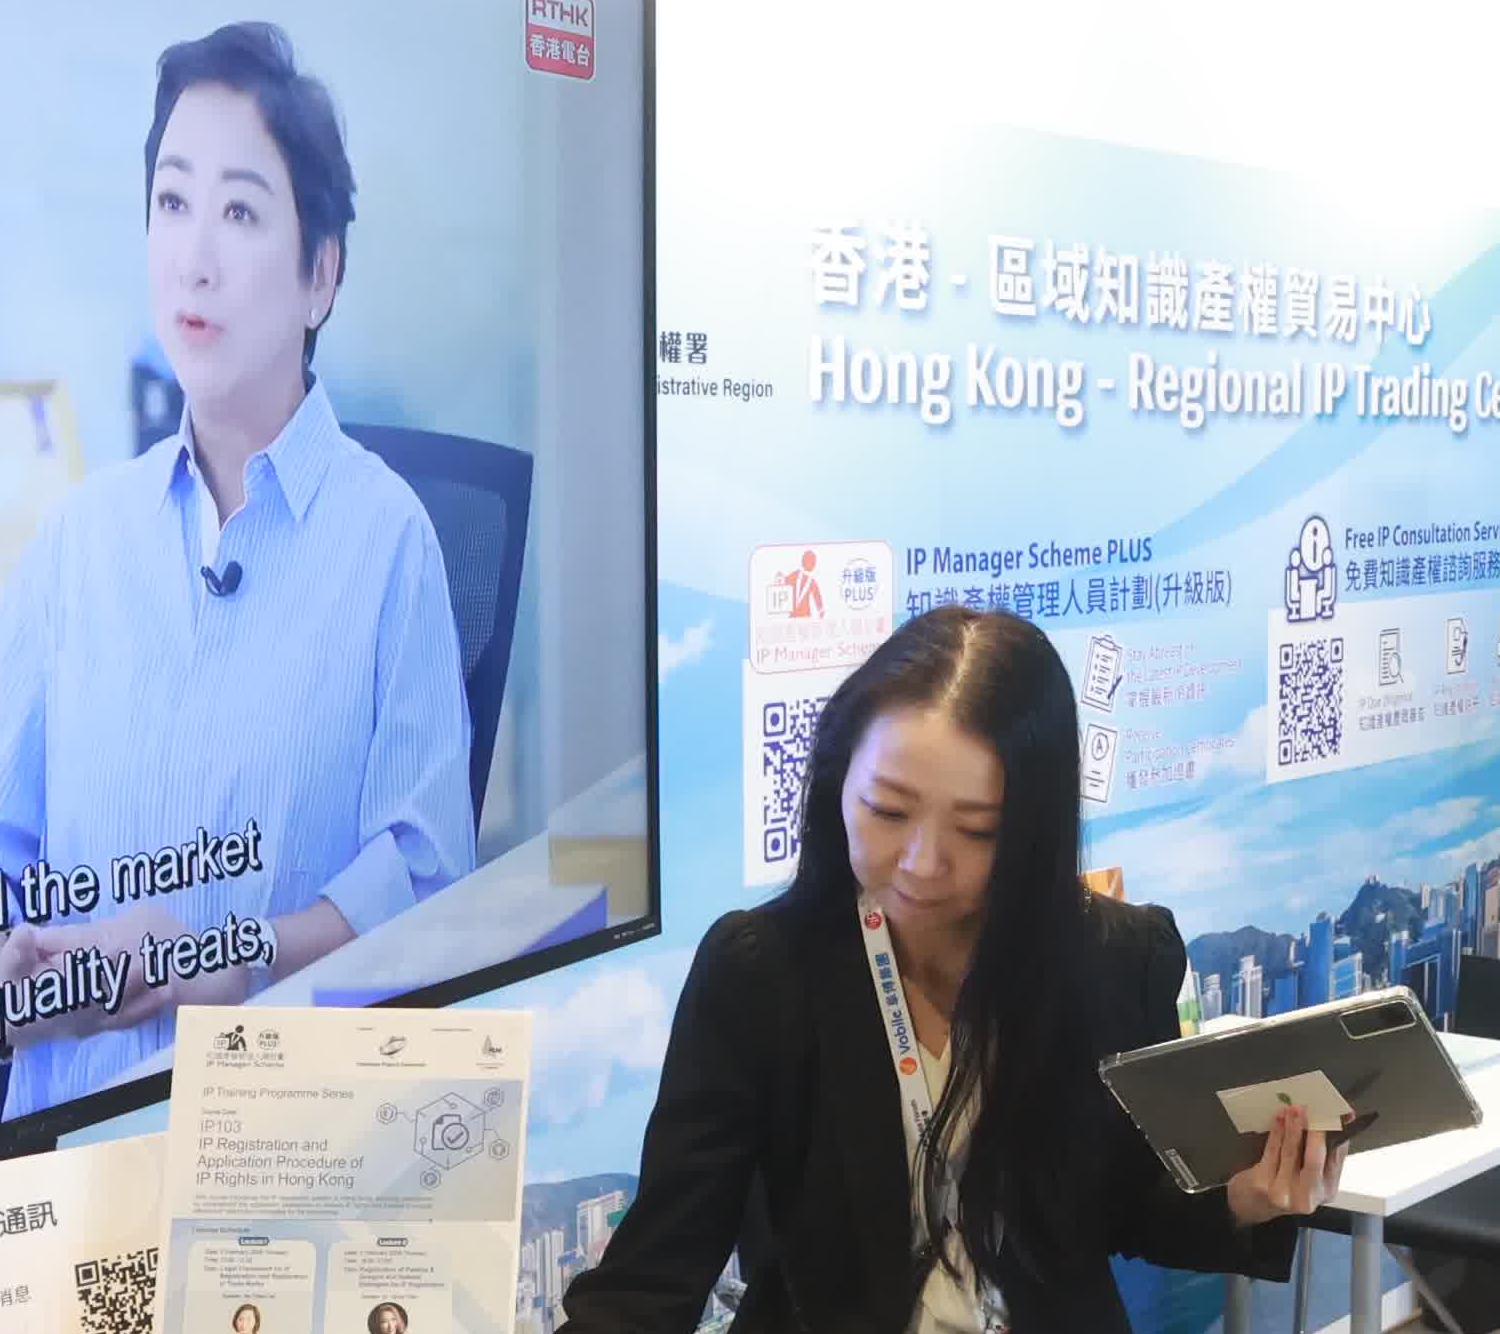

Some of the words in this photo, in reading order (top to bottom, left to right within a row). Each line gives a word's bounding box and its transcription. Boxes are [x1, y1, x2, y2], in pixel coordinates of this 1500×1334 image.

[529, 31, 591, 68] 香港電台
[810, 220, 932, 312] 香港
[988, 233, 1433, 348] 區域知識產權貿易中心
[659, 330, 709, 365] 權署
[723, 377, 774, 403] Region
[809, 332, 953, 427] Hong
[965, 341, 1086, 429] Kong
[1128, 349, 1302, 430] Regional
[1312, 362, 1348, 418] IP
[1355, 362, 1470, 434] Trading
[1344, 526, 1375, 550] Free
[1377, 525, 1391, 548] IP
[1392, 521, 1471, 548] Consultation
[906, 546, 928, 576] IP
[932, 545, 1024, 579] Manager
[1027, 541, 1101, 570] Scheme
[1106, 536, 1153, 565] PLUS
[772, 590, 790, 609] IP
[843, 586, 875, 603] PLUS
[21, 859, 101, 925] the
[110, 817, 264, 902] market
[141, 911, 278, 987] treats,
[891, 1008, 912, 1055] Vobile
[202, 1087, 215, 1100] IP
[215, 1086, 257, 1101] Training
[259, 1087, 318, 1102] Programme
[320, 1087, 355, 1100] Series
[200, 1119, 243, 1135] IP103
[198, 1138, 216, 1152] IP
[218, 1137, 299, 1154] Registration
[301, 1138, 329, 1152] and
[196, 1154, 272, 1170] Application
[276, 1155, 355, 1170] Procedure
[357, 1155, 365, 1169] of
[195, 1173, 213, 1187] IP
[216, 1172, 258, 1189] Rights
[261, 1173, 274, 1187] in
[277, 1173, 315, 1190] Hong
[318, 1173, 356, 1190] Kong
